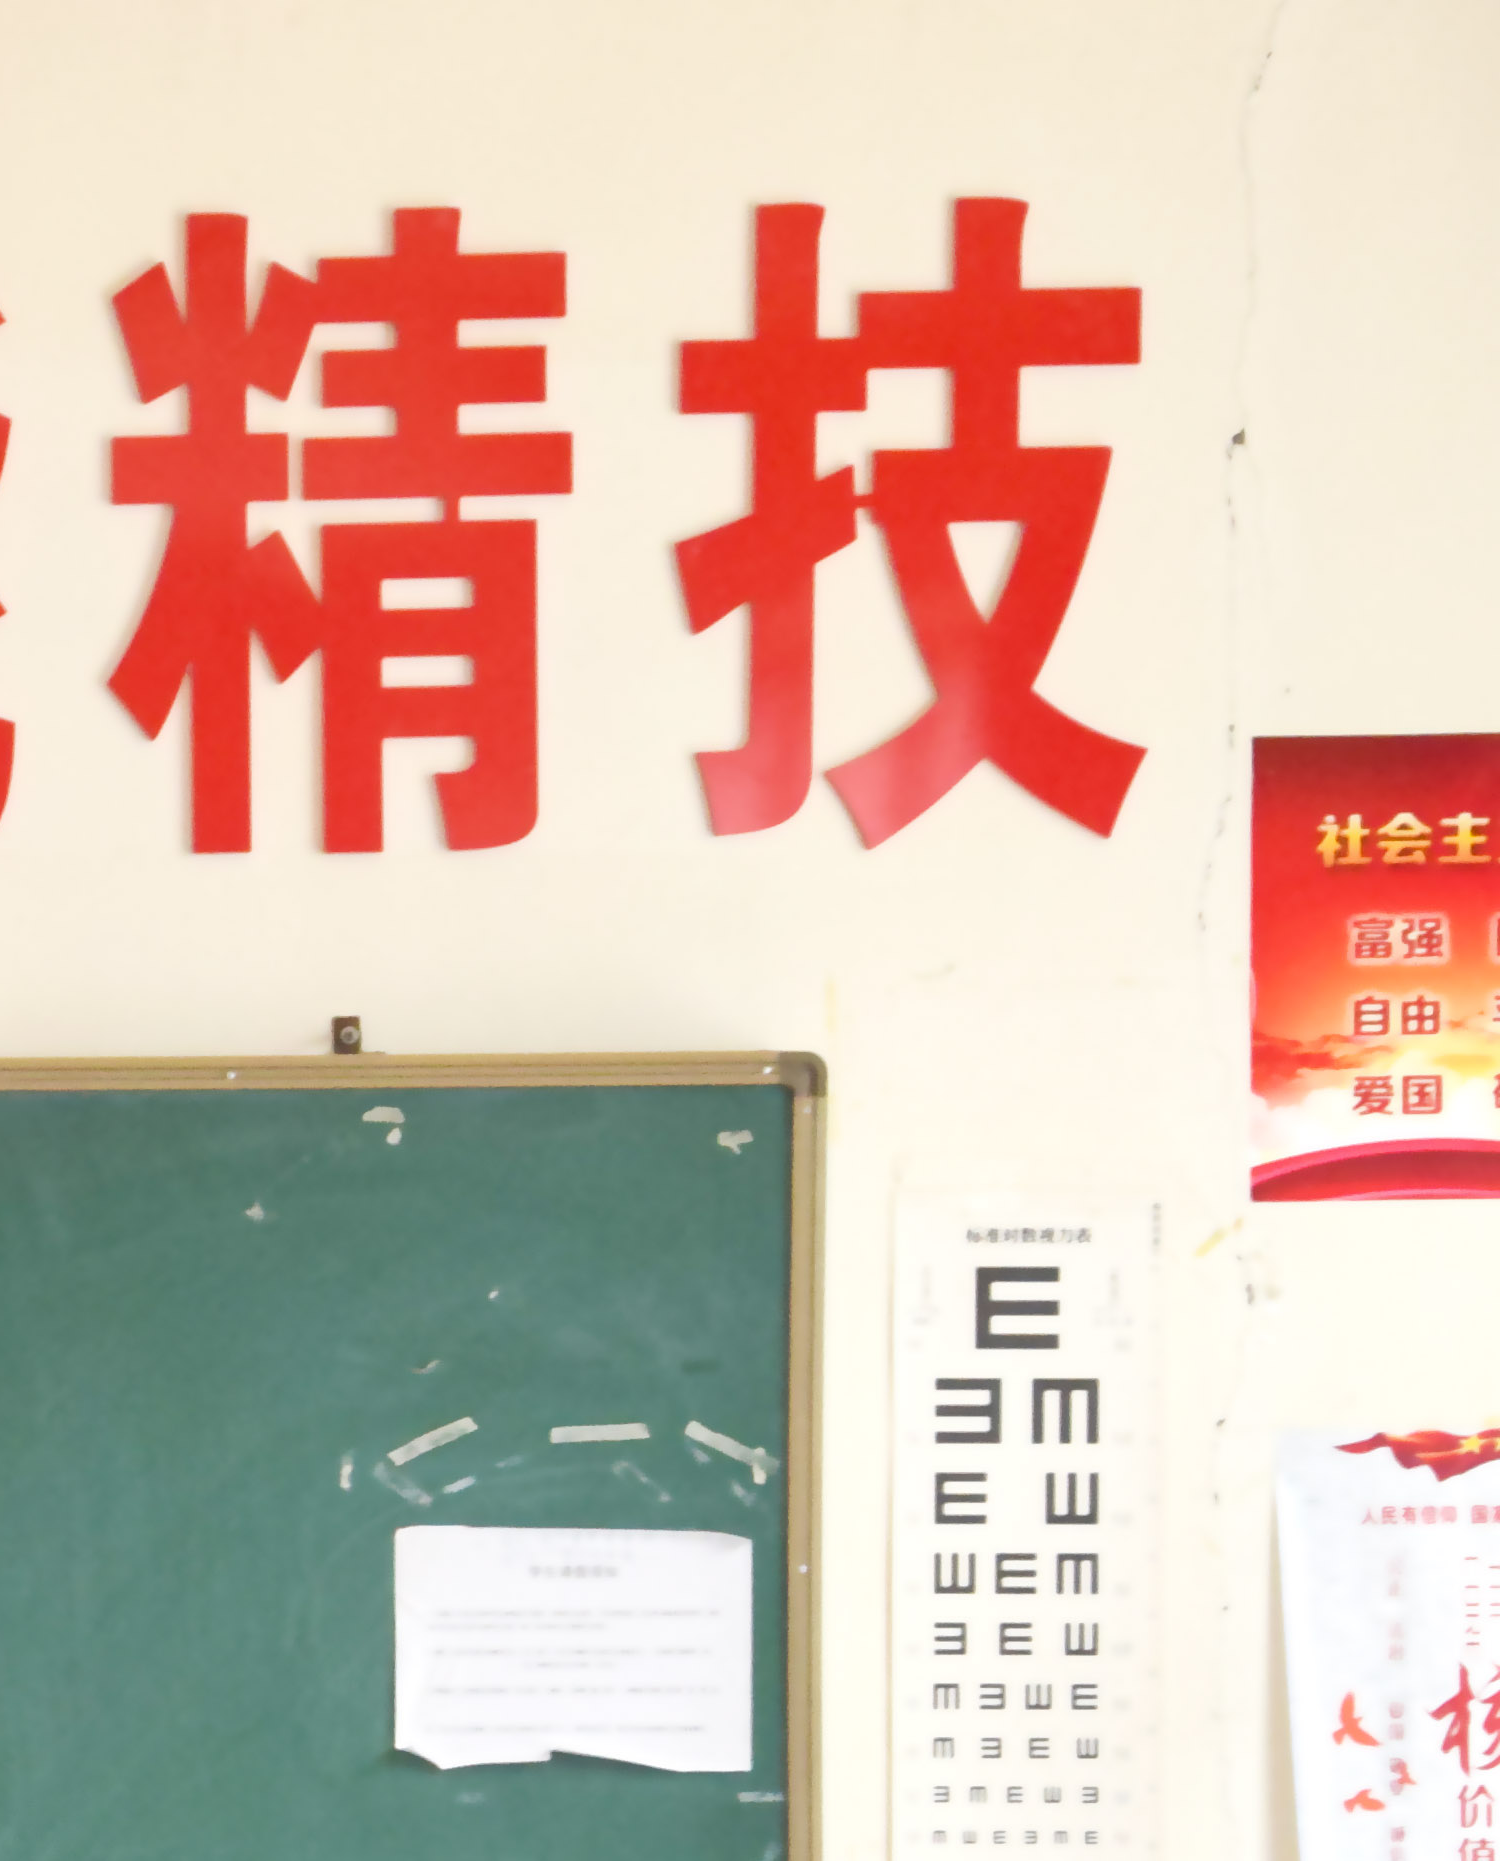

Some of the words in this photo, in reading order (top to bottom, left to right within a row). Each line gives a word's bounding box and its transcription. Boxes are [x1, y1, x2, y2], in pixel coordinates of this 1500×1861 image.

[1316, 811, 1500, 868] 社会主
[1352, 915, 1445, 960] 富强
[1352, 994, 1442, 1037] 自由
[1352, 1074, 1444, 1117] 爱国
